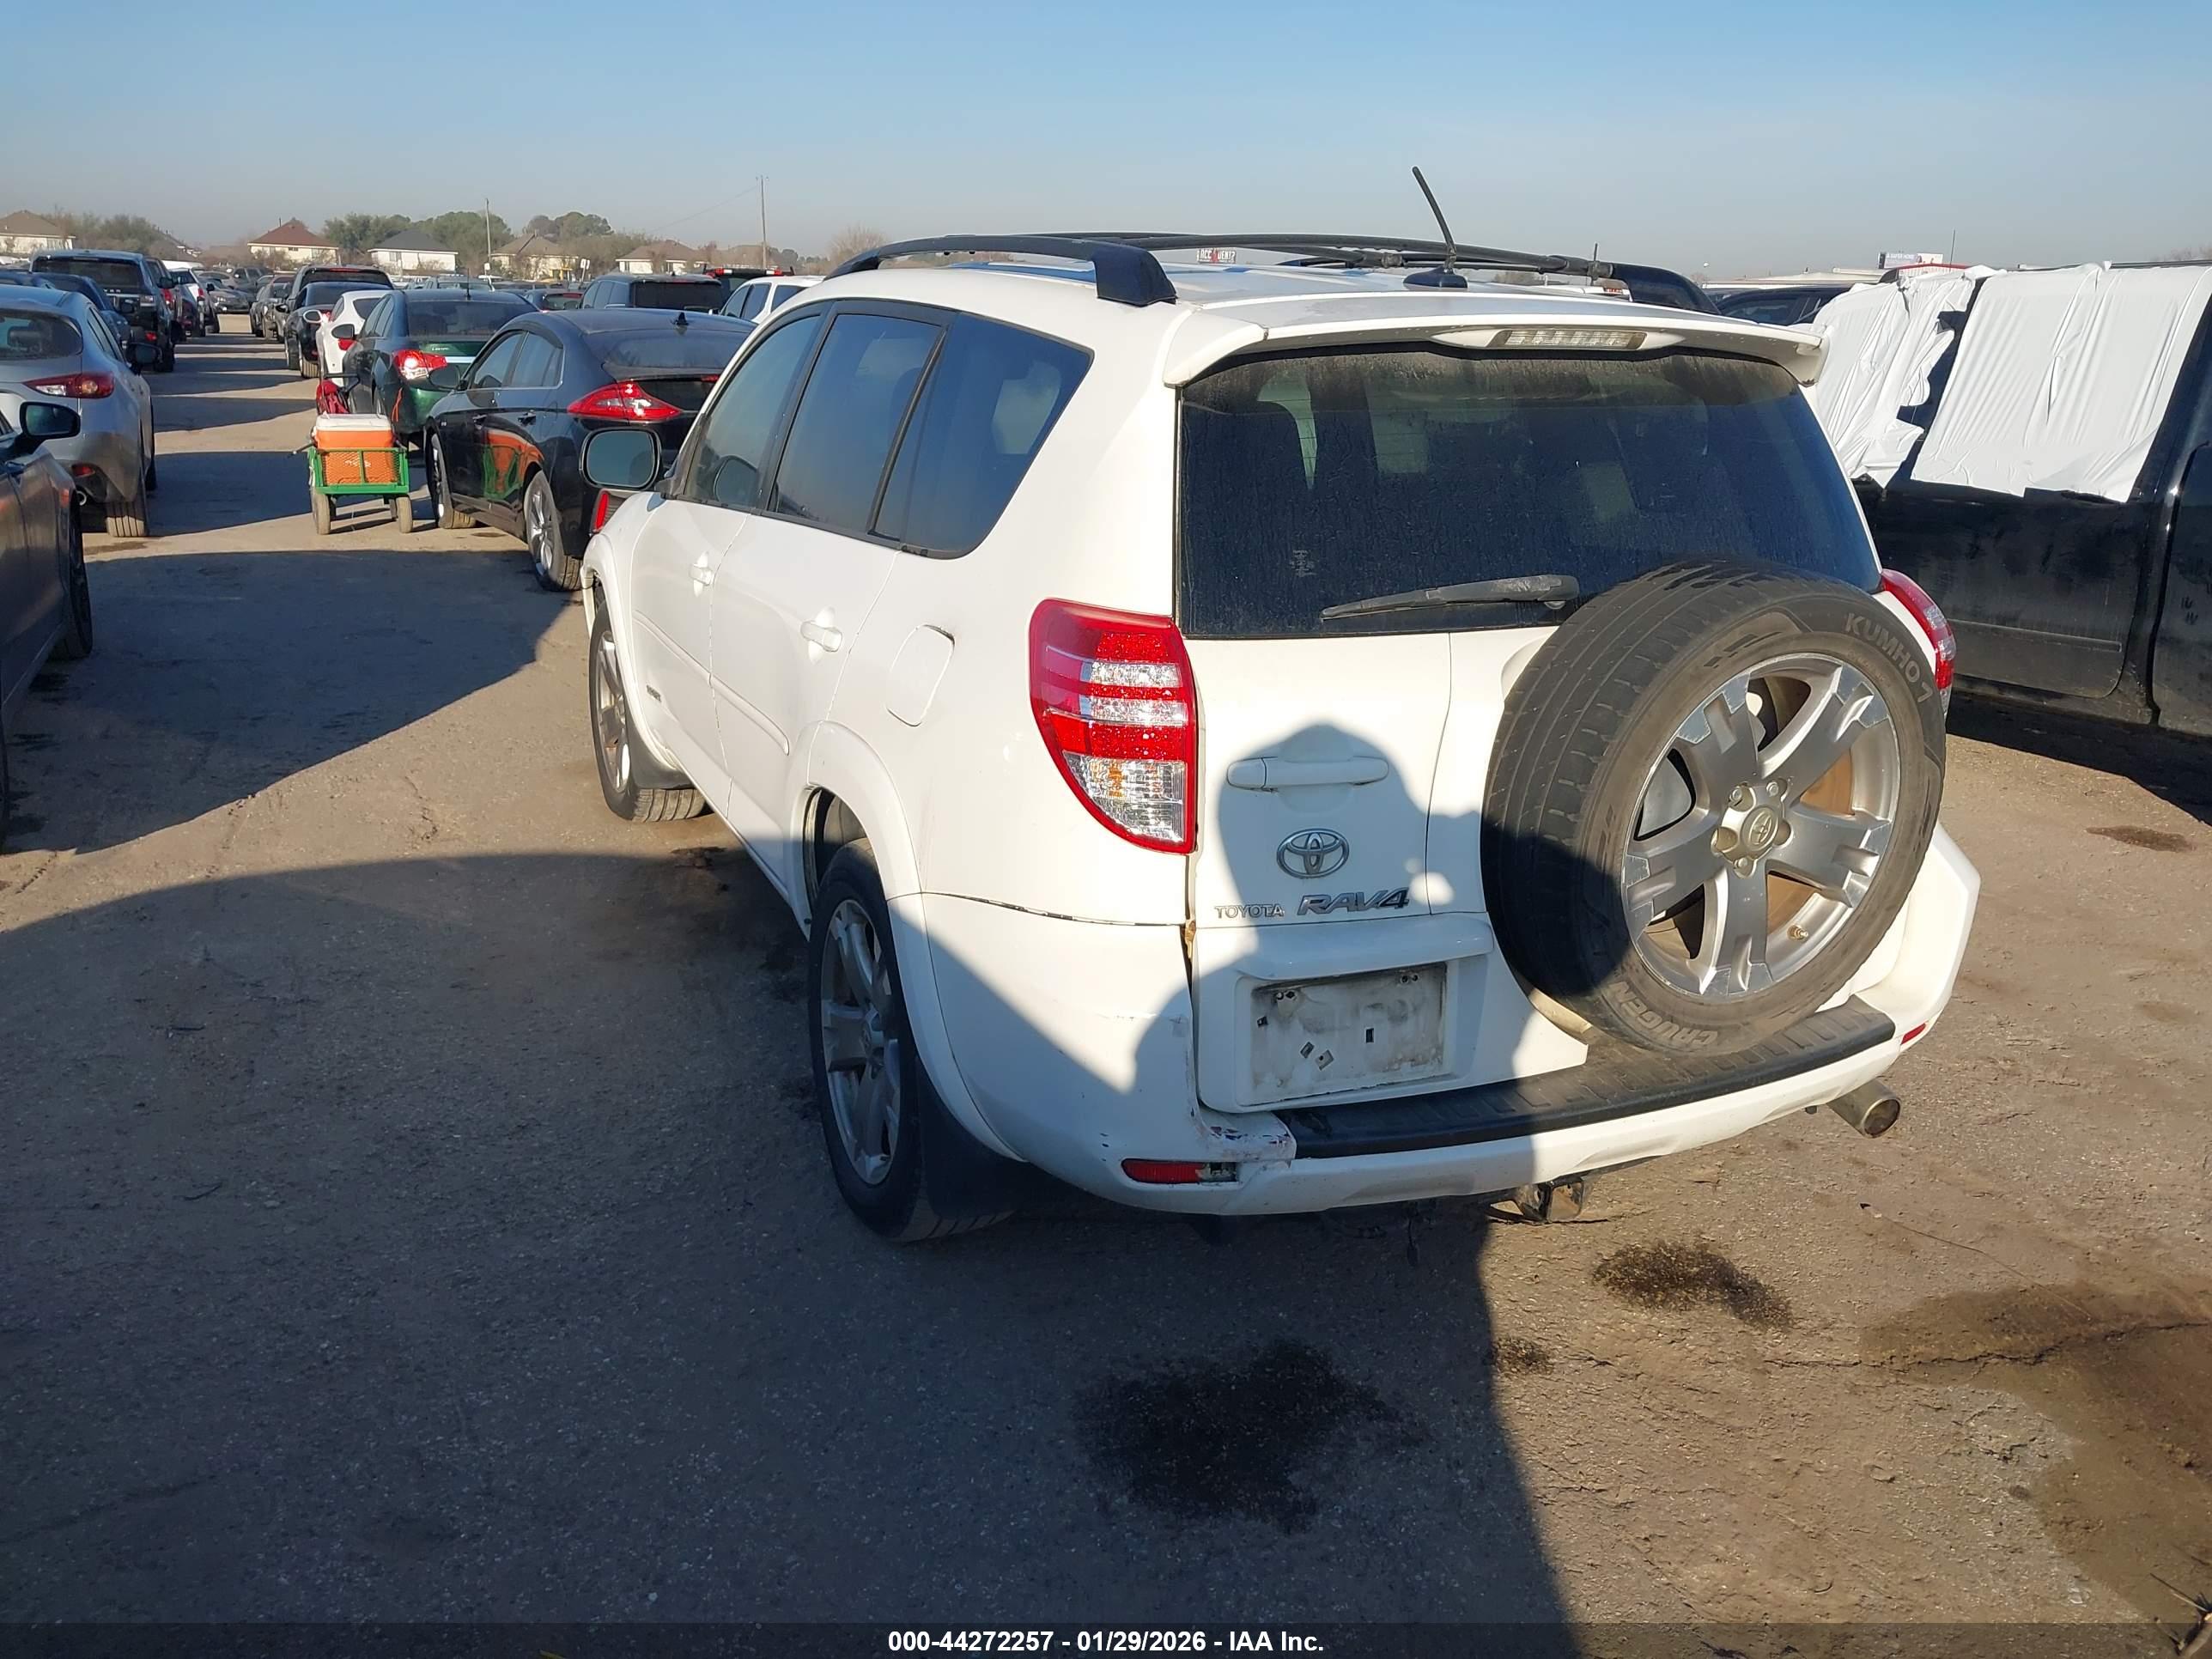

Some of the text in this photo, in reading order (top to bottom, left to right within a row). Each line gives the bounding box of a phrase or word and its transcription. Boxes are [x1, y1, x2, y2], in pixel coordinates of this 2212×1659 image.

[1845, 613, 1921, 683] KUMHO
[1214, 886, 1410, 919] TOYOTA RAV4
[1604, 981, 1718, 1045] CRUGEN
